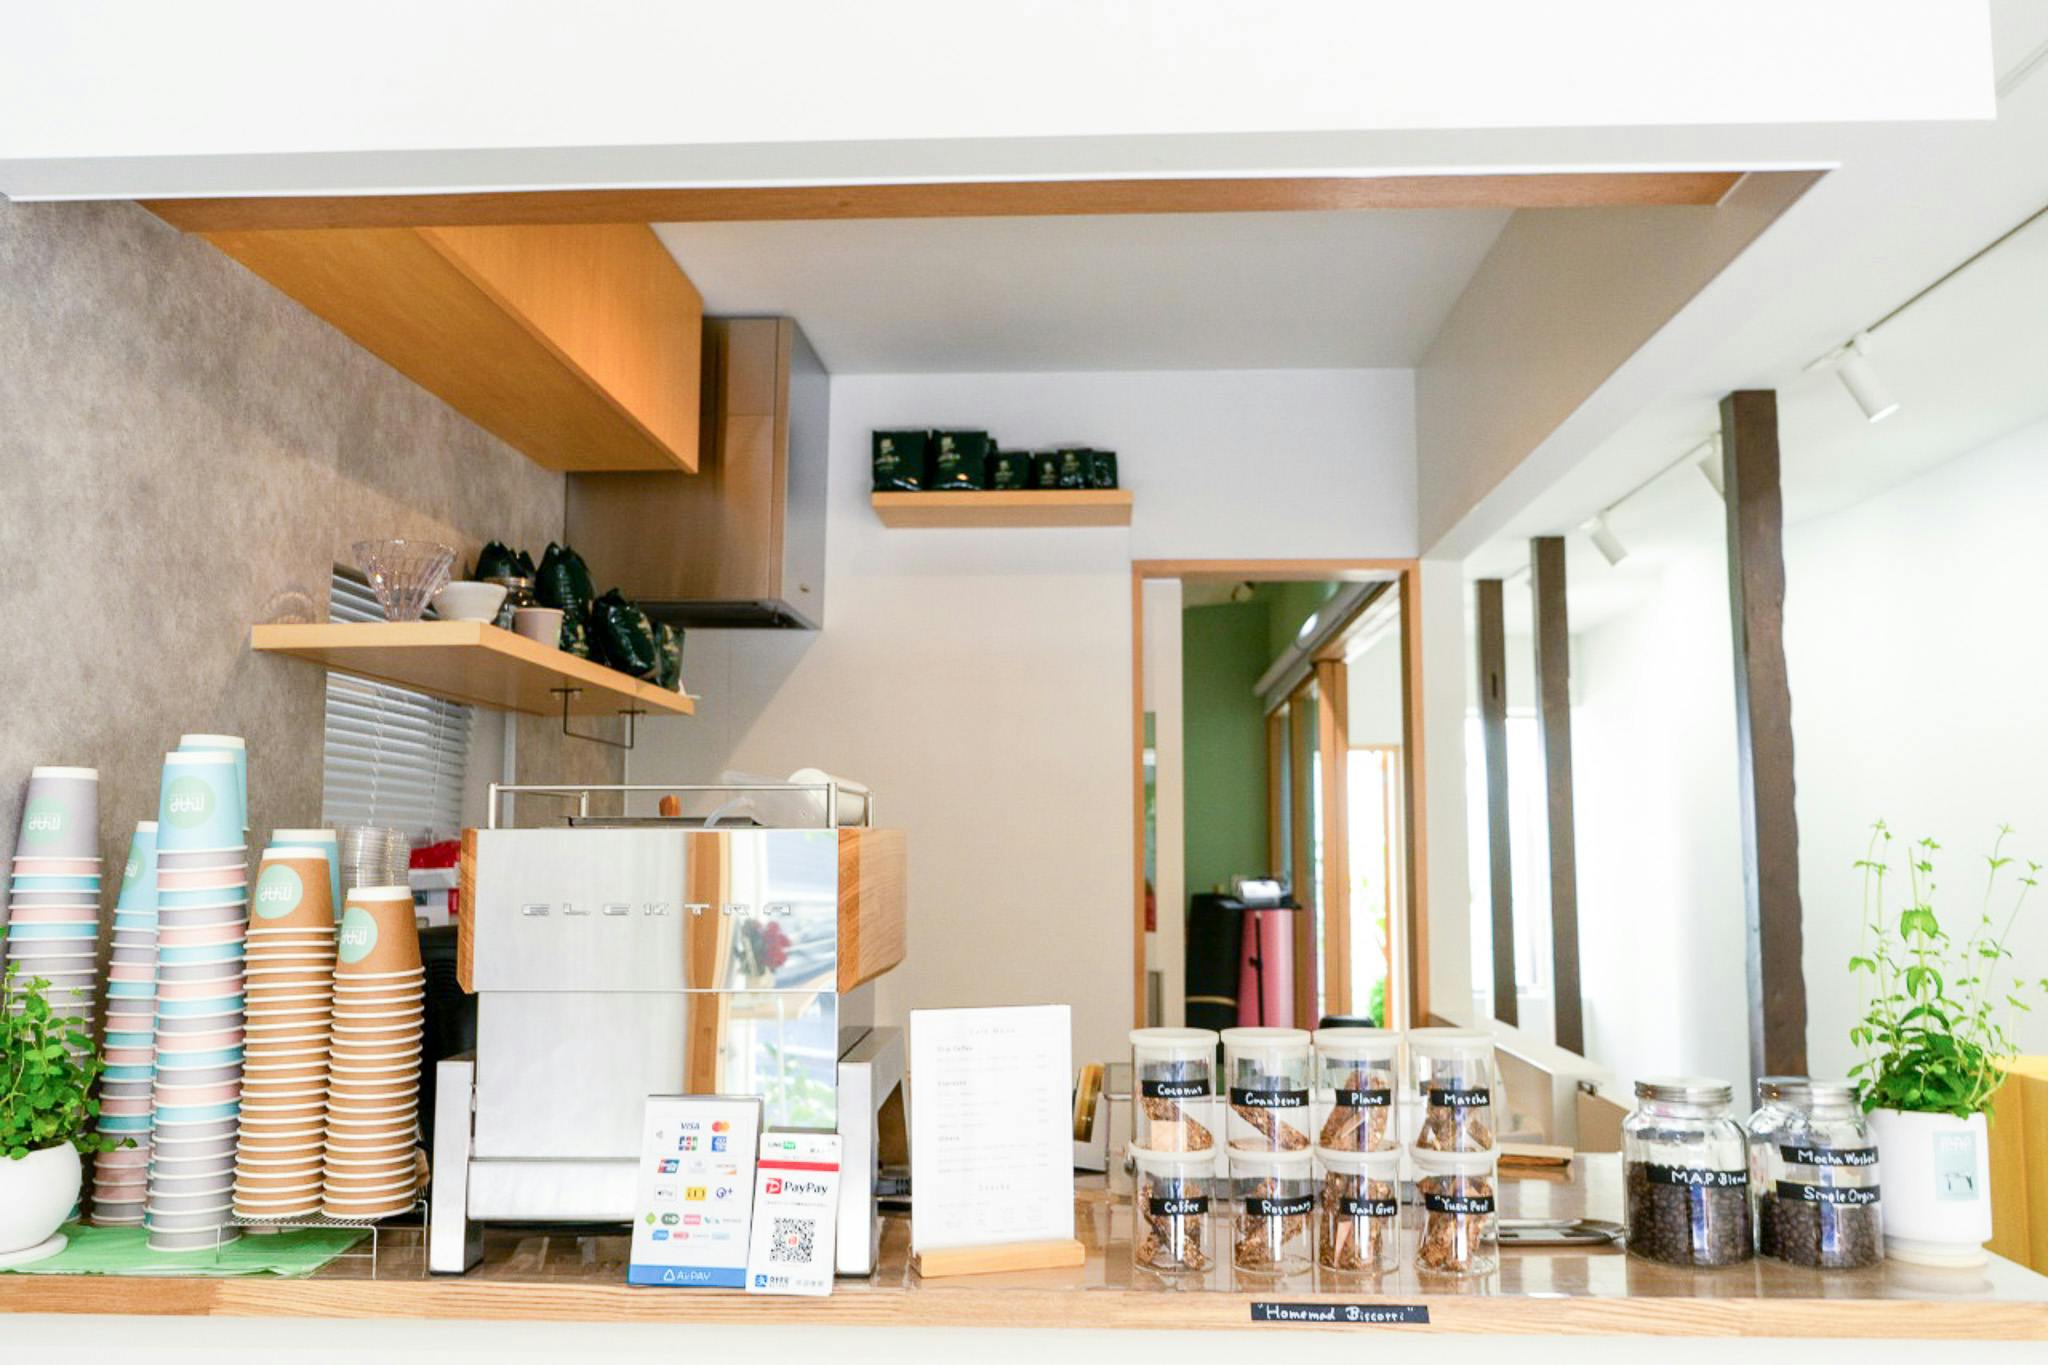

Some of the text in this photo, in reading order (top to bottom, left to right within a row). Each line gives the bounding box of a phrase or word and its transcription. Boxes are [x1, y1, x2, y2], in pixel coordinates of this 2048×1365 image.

[1156, 1083, 1204, 1096] Coconut
[1443, 1093, 1489, 1106] Matcha
[1797, 1149, 1844, 1166] Mocha
[1718, 1172, 1747, 1187] Blend
[783, 1180, 829, 1197] PayPay
[1163, 1199, 1199, 1214] Coffee
